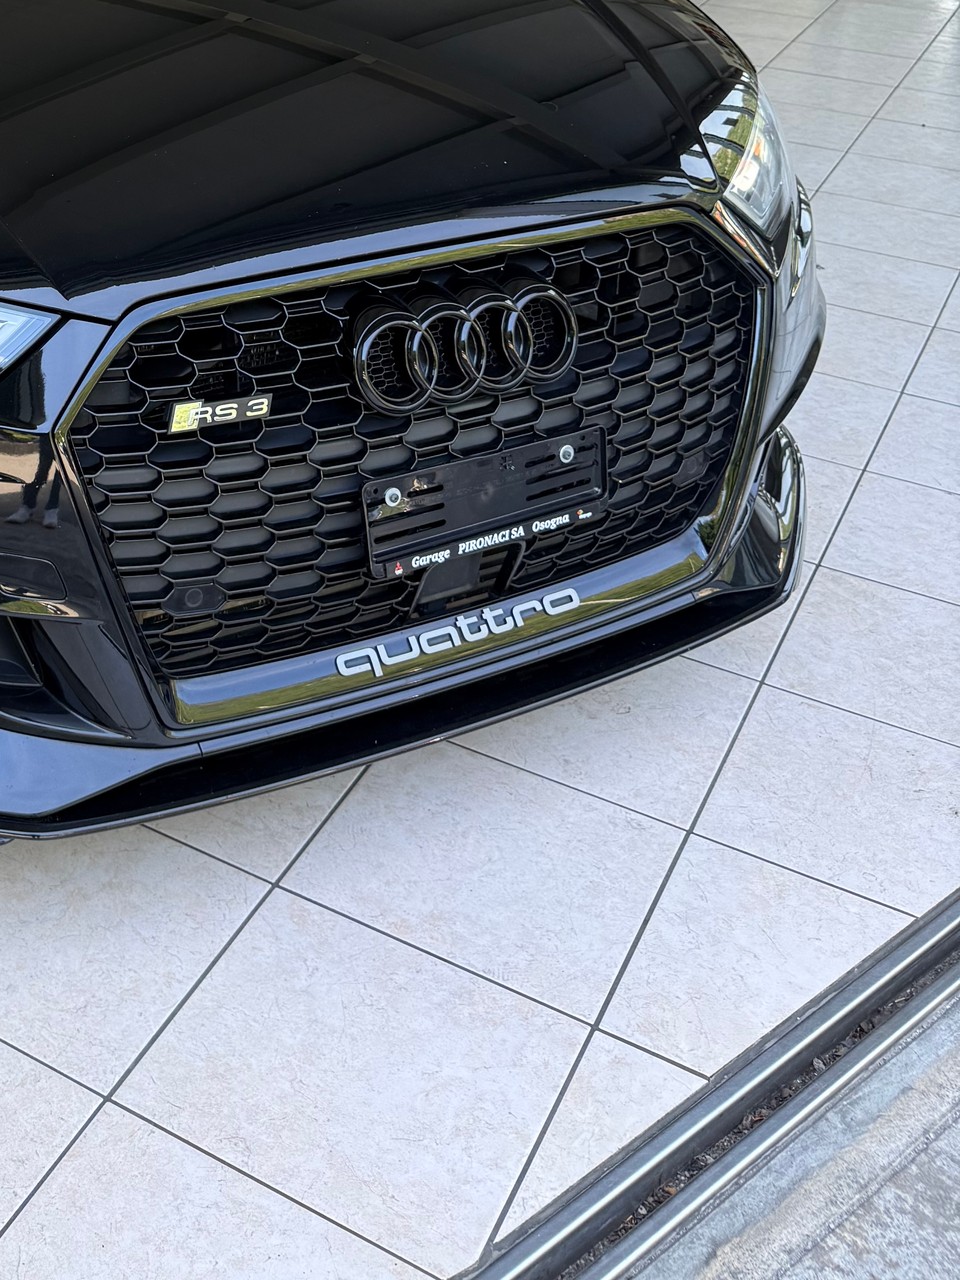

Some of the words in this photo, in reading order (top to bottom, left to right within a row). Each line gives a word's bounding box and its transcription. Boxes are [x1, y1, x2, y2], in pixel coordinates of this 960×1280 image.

[411, 548, 451, 568] Garage
[457, 531, 510, 555] PIRONACI
[511, 525, 525, 539] SA
[531, 513, 570, 533] Osogna
[336, 587, 581, 678] quattro
